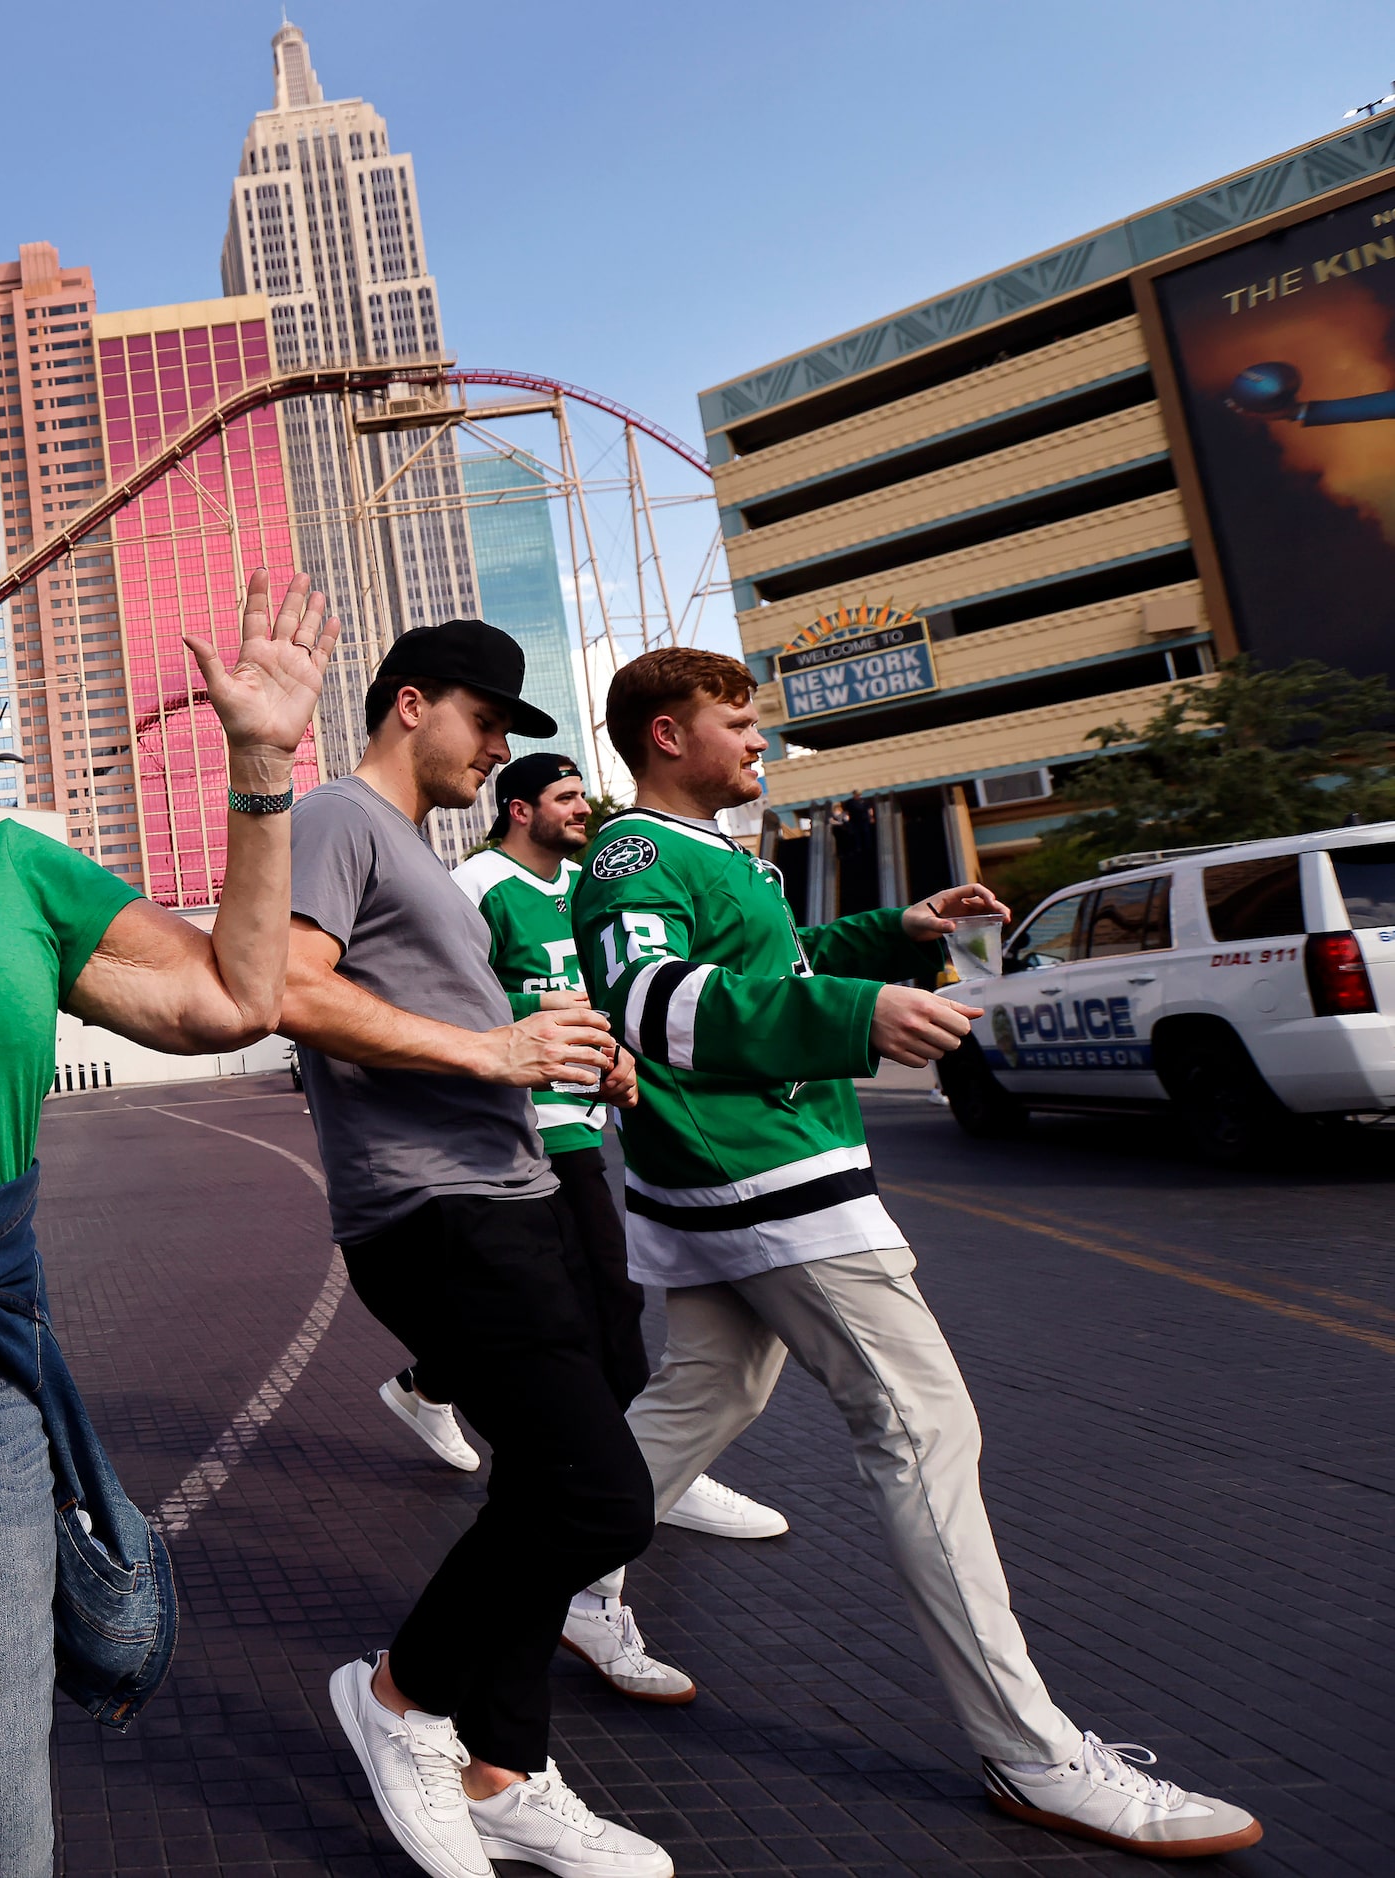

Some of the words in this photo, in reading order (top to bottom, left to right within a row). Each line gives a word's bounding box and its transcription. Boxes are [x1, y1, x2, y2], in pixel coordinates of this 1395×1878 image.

[1221, 267, 1303, 315] THE
[797, 637, 877, 666] WELCOME
[882, 630, 904, 644] TO
[789, 663, 846, 695] NEW
[850, 648, 921, 680] YORK
[793, 684, 849, 715] NEW
[855, 668, 925, 700] YORK
[597, 838, 651, 862] DALLAS
[599, 911, 669, 989] 12
[1211, 954, 1253, 968] DIAL
[1259, 948, 1299, 964] 911
[1013, 996, 1137, 1042] POLICE
[1025, 1051, 1144, 1066] HENDERSON
